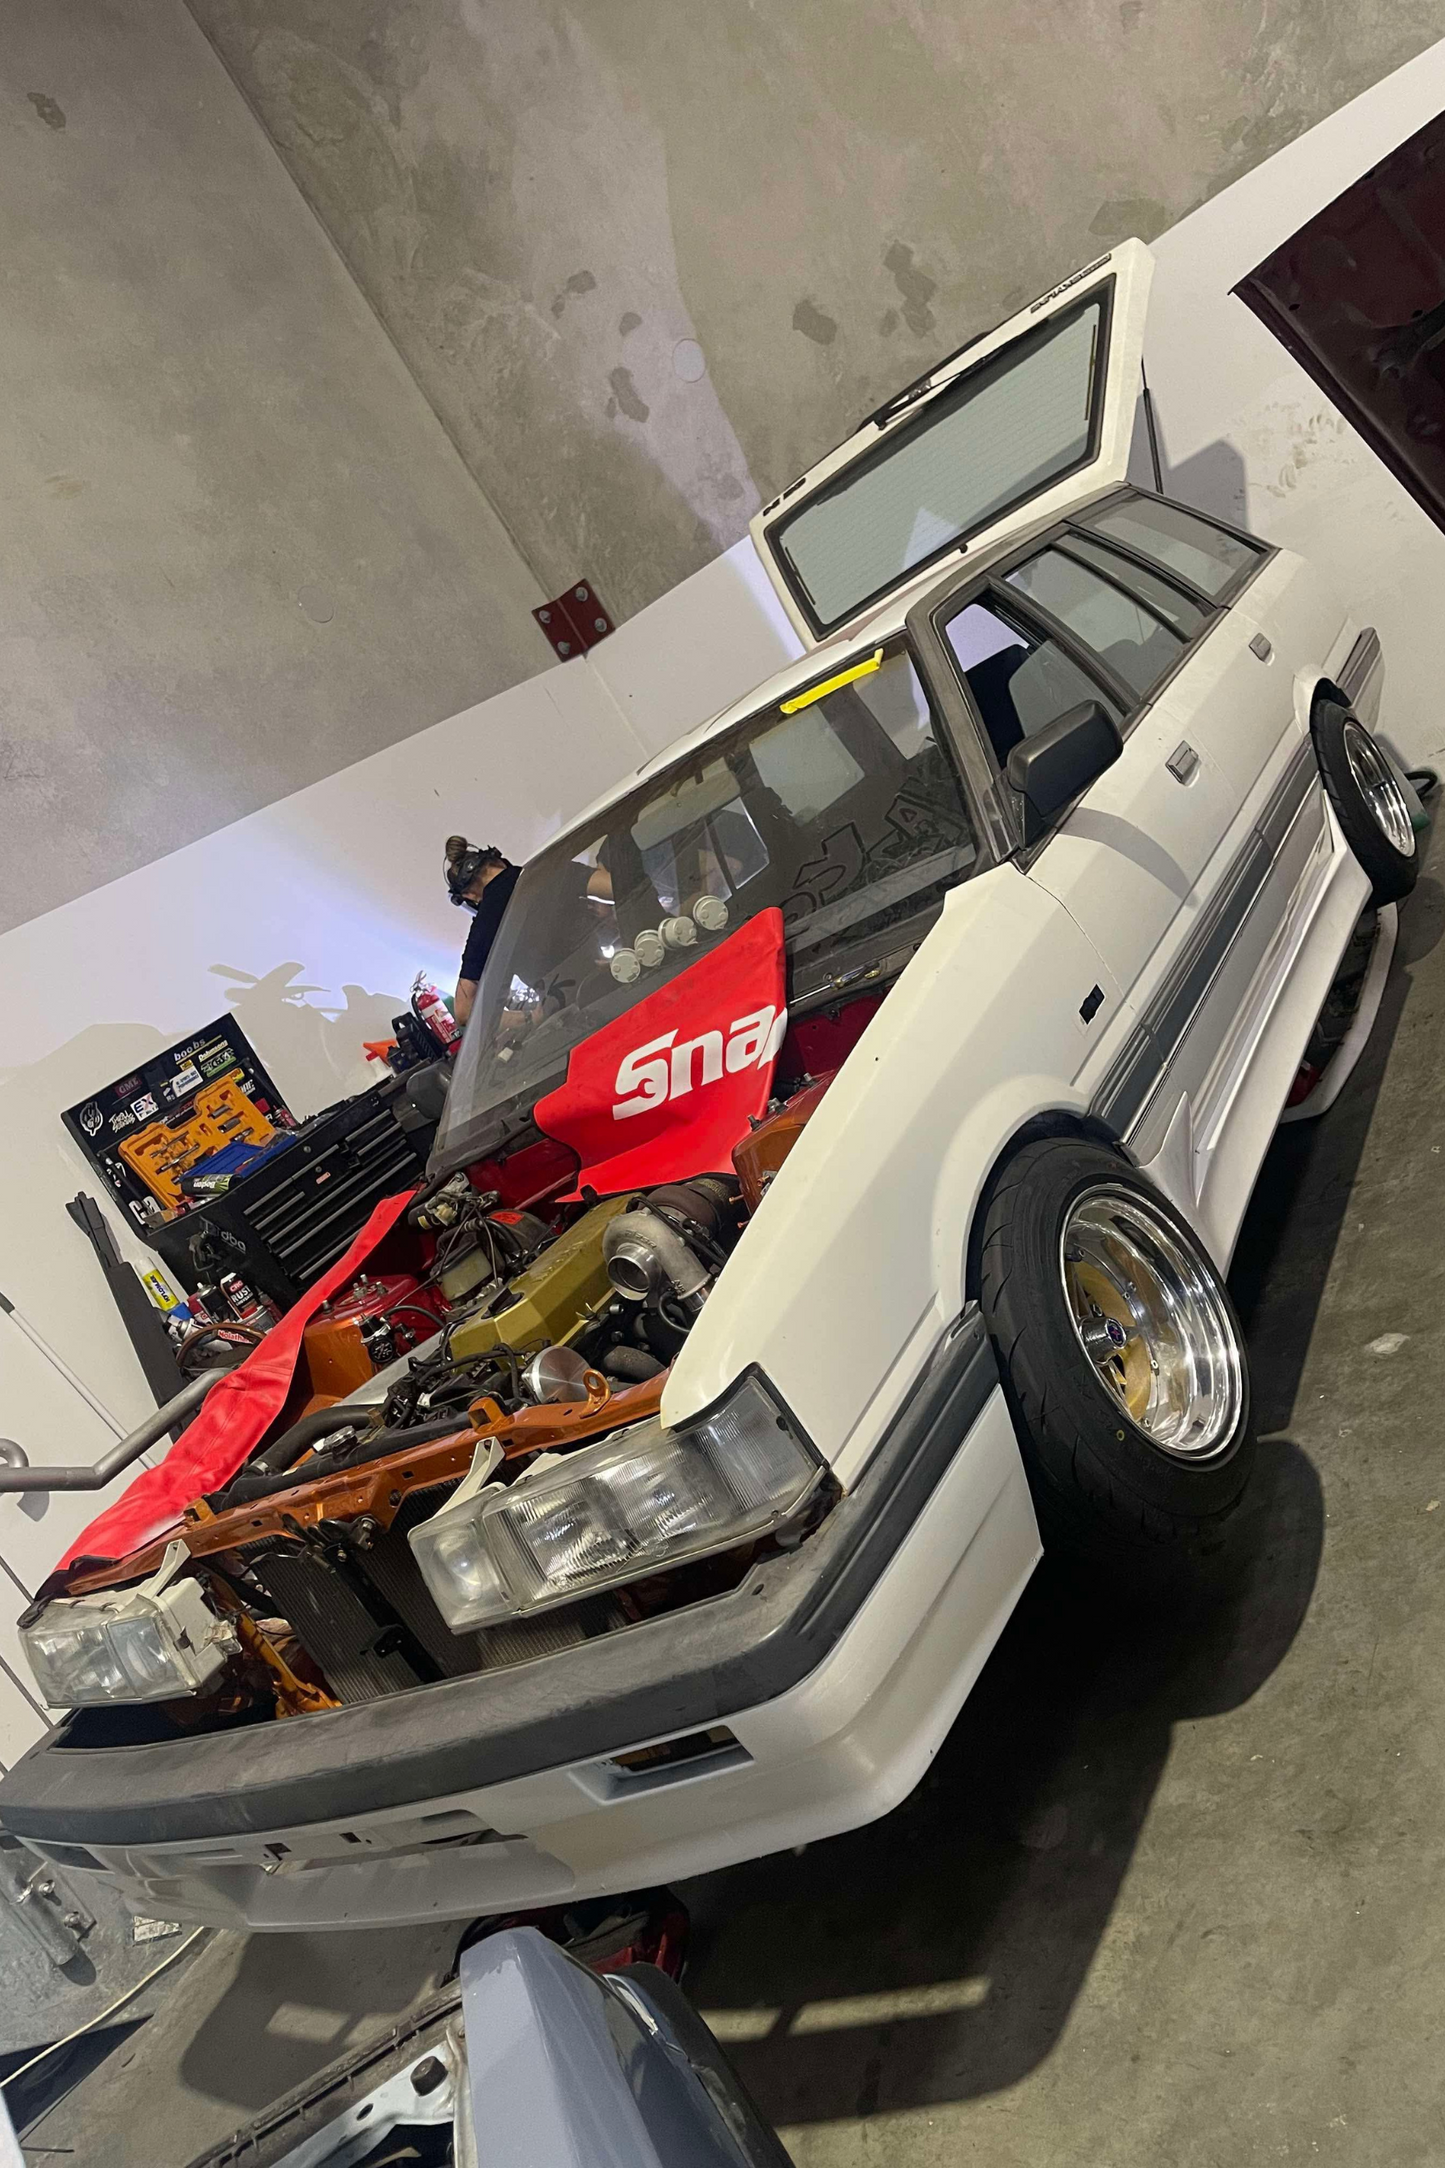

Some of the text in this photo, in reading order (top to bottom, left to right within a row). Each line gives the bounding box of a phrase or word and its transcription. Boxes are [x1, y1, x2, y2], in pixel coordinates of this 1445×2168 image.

[173, 1038, 206, 1062] boobs
[220, 1230, 247, 1253] dba
[231, 1287, 252, 1303] RUST
